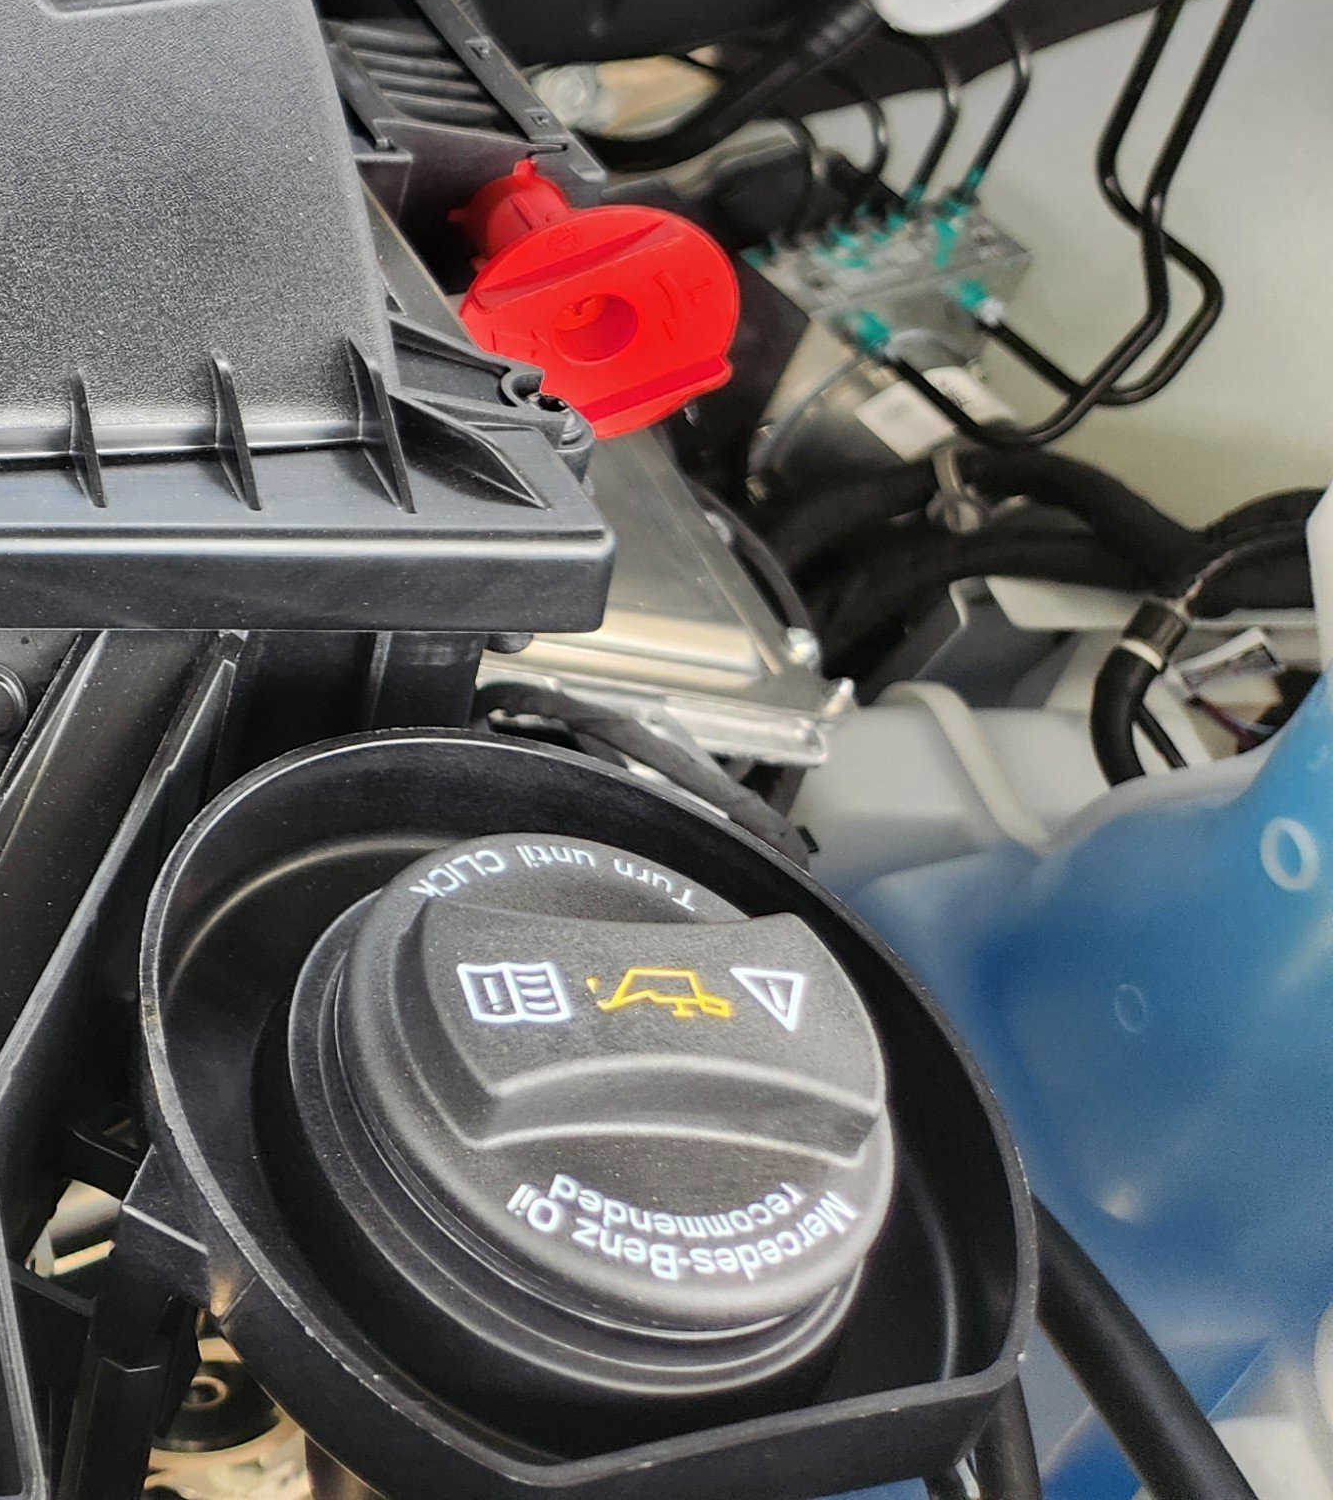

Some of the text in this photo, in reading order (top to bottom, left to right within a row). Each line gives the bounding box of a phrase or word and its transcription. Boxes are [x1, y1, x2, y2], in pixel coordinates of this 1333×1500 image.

[408, 845, 696, 912] Turn until CLICK
[505, 1183, 858, 1281] Mercedes-Benz Oil
[548, 1173, 804, 1240] recommended
